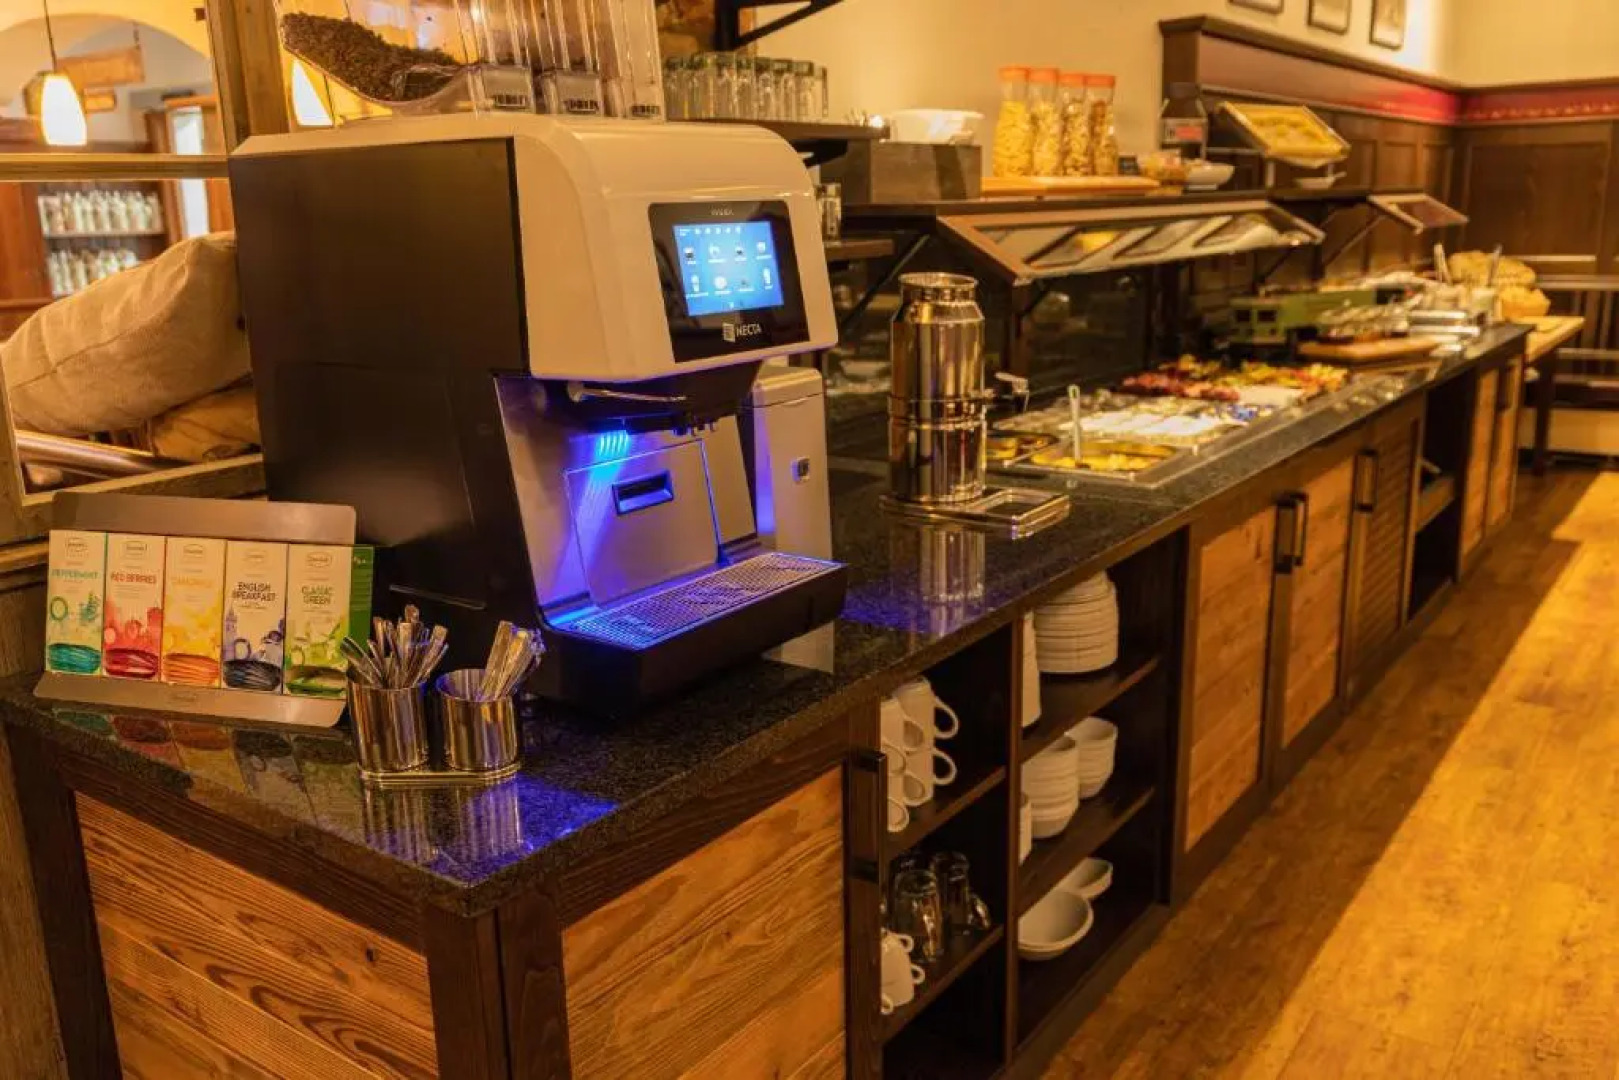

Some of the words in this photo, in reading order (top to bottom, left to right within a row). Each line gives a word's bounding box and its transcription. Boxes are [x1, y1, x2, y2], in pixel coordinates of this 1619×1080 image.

[736, 323, 762, 337] NECTA
[111, 572, 125, 582] RED
[126, 573, 156, 584] BERRIES
[238, 582, 270, 592] ENGLISH
[232, 591, 275, 601] BREAKFAST
[303, 595, 330, 604] GREEN
